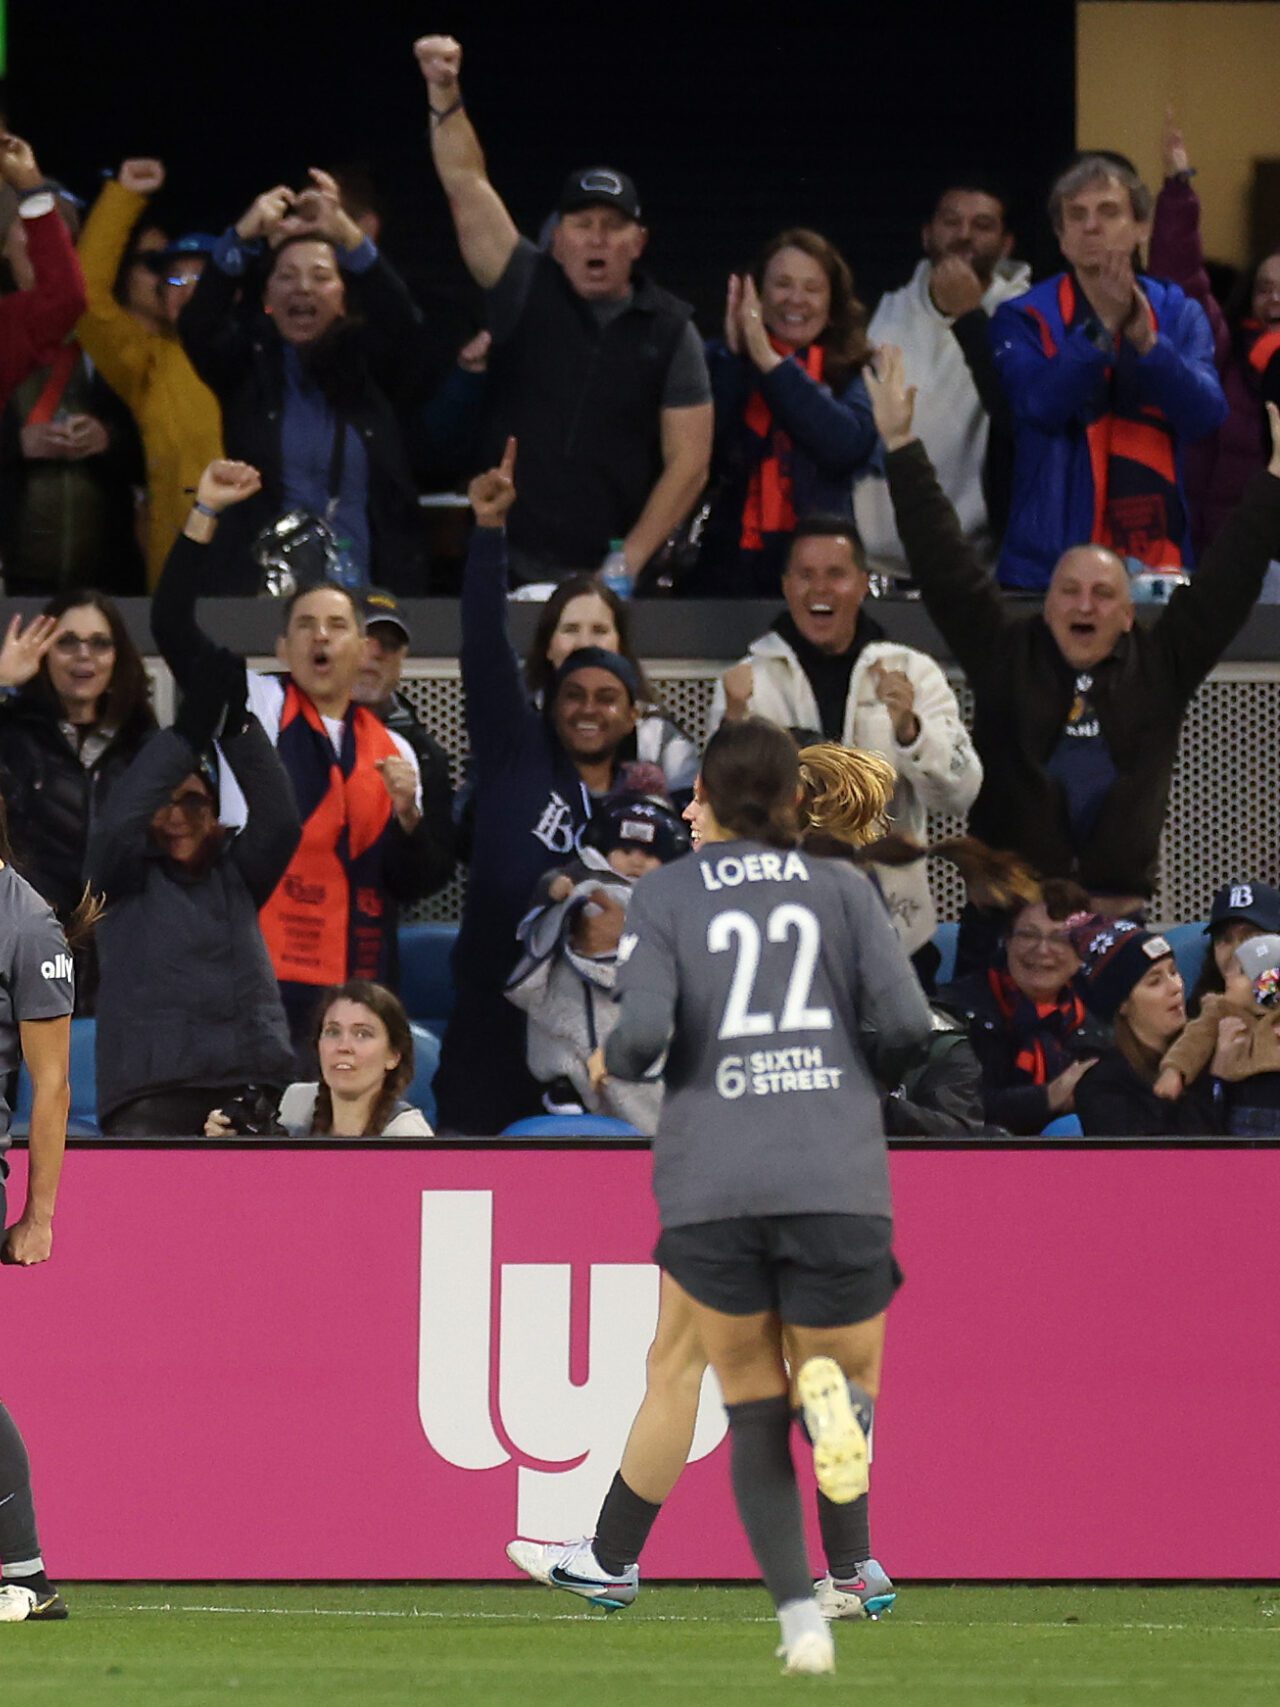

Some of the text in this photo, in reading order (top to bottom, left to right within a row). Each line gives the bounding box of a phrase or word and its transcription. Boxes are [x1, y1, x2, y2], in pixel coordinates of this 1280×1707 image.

[700, 852, 809, 891] LOERA
[707, 903, 833, 1040] 22
[716, 1056, 747, 1099] 6
[749, 1046, 823, 1074] SIXTH
[752, 1067, 843, 1096] STREET
